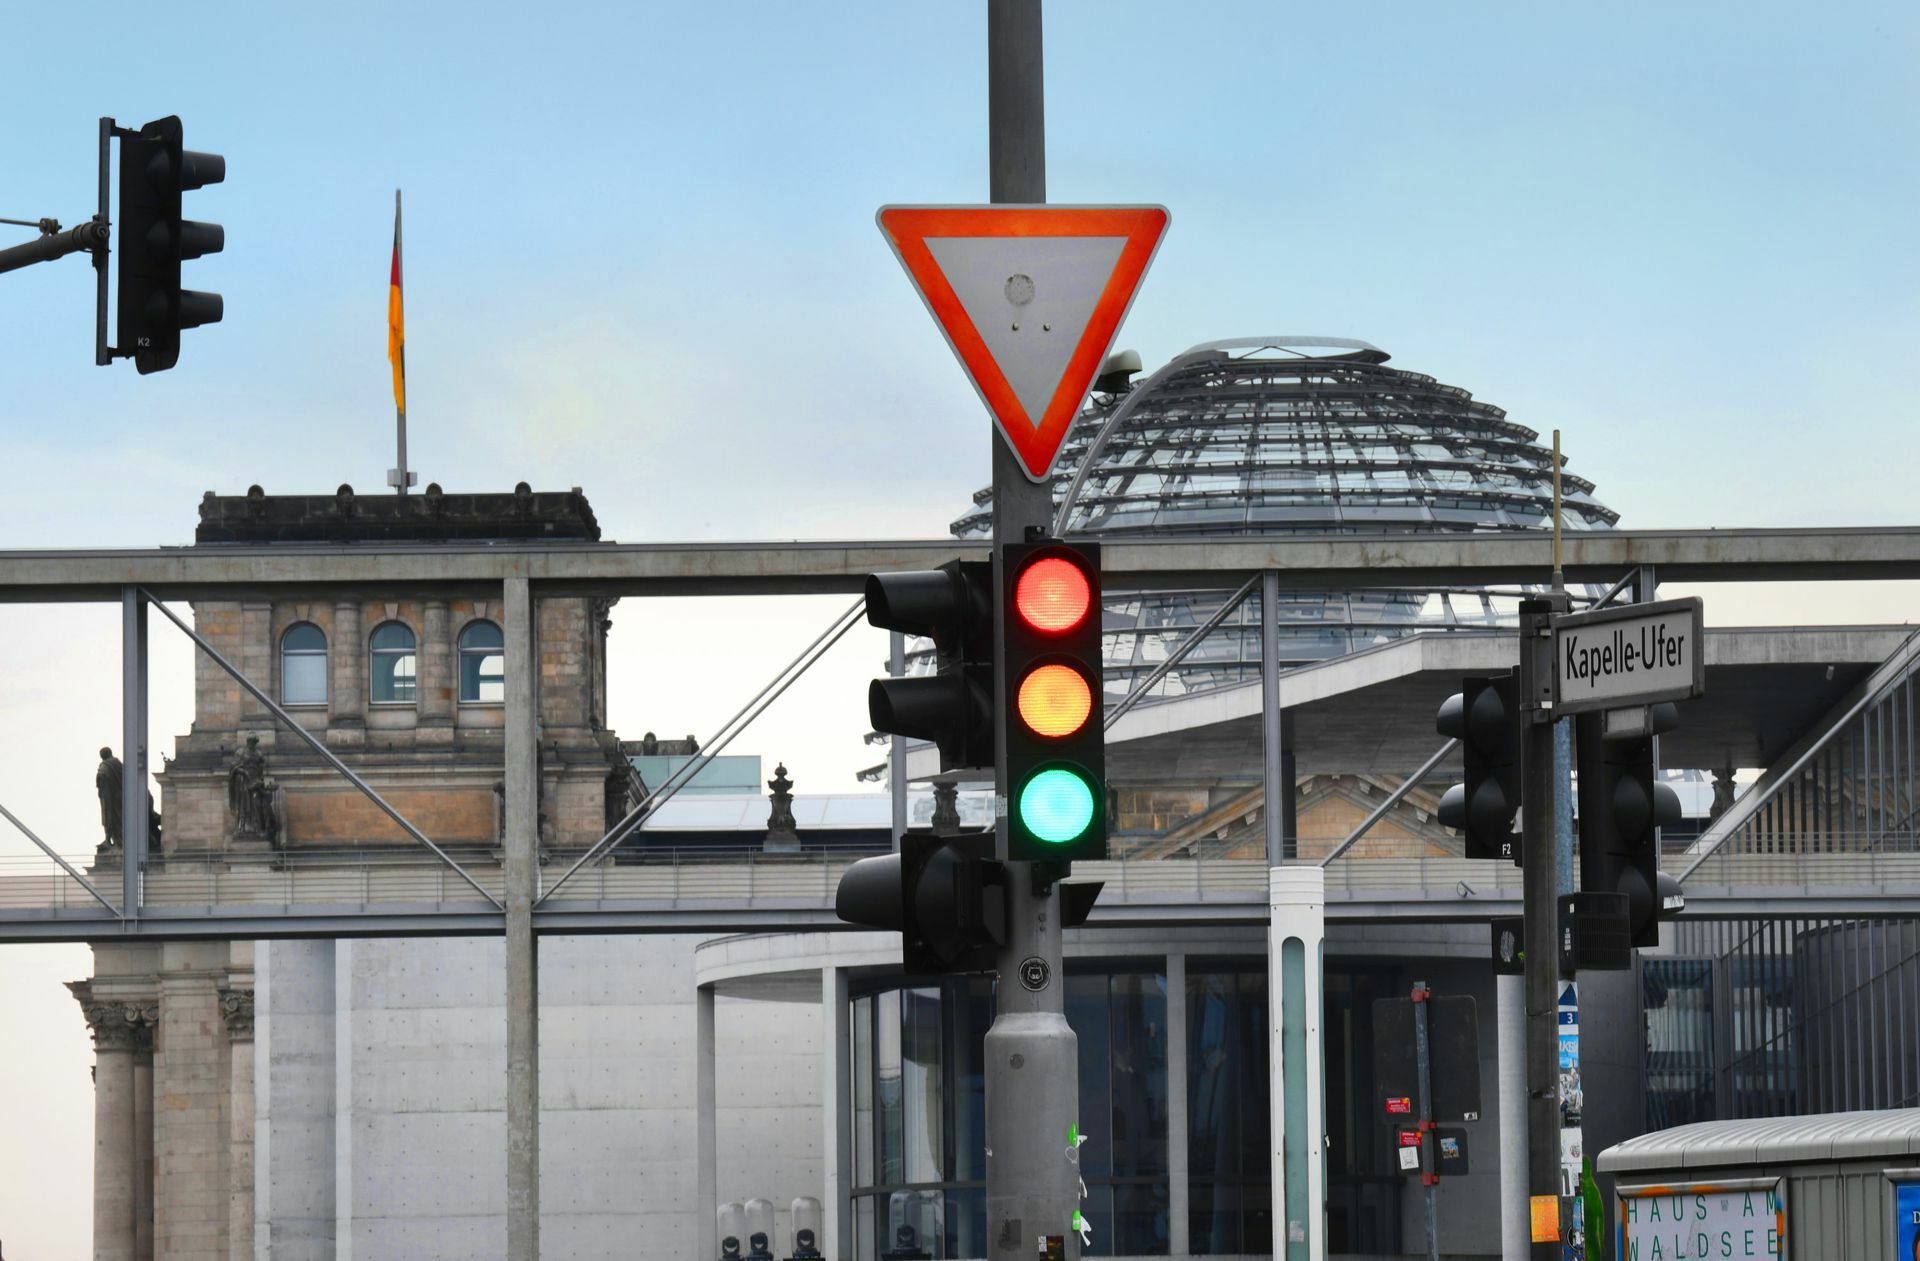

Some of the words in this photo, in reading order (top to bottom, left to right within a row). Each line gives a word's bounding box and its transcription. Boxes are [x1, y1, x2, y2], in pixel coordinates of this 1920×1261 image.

[138, 337, 150, 347] K2
[1566, 623, 1684, 688] Kapelle-Ufer
[1502, 843, 1511, 855] F2
[1567, 1012, 1573, 1024] 3
[1627, 1194, 1707, 1223] HAUS
[1743, 1191, 1777, 1216] AM
[1627, 1229, 1777, 1261] WALDSEE
